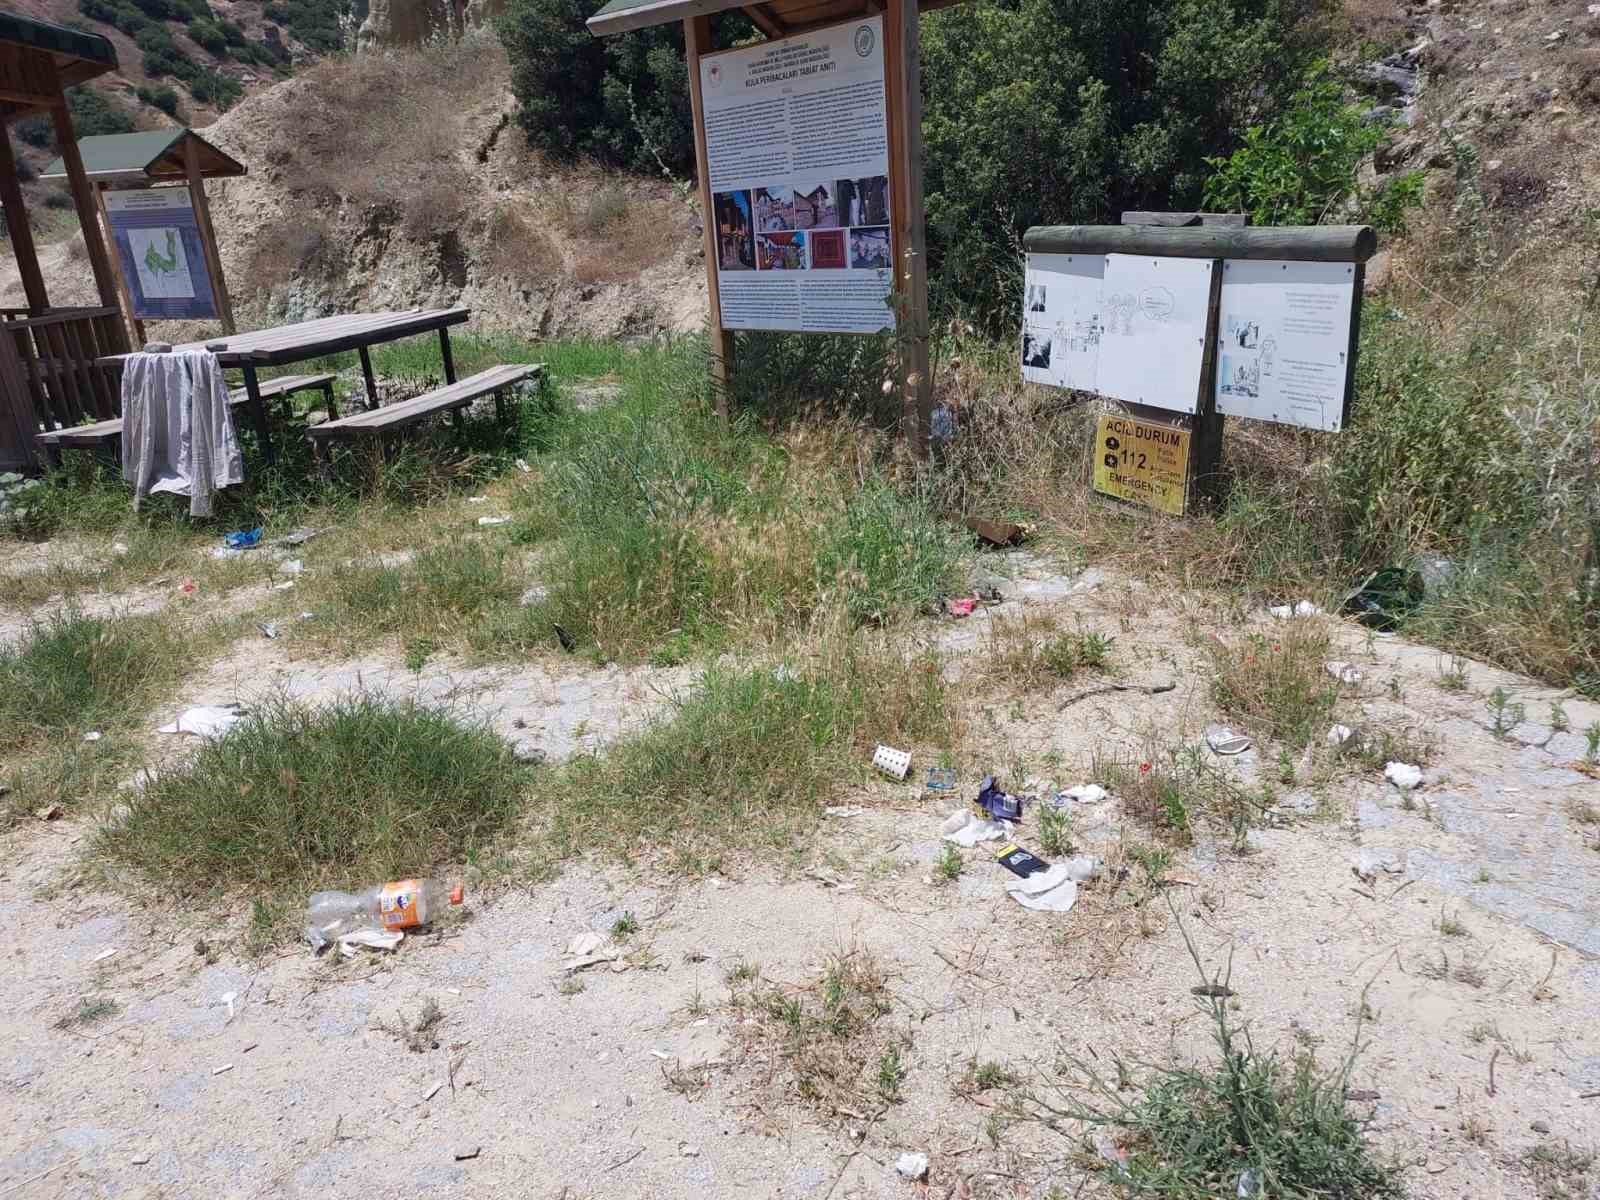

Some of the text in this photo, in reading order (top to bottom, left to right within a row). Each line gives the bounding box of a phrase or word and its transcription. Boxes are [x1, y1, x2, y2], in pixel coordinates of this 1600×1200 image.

[1136, 426, 1180, 447] DURUM
[1121, 449, 1147, 469] 112
[1109, 472, 1168, 496] EMERGENCY
